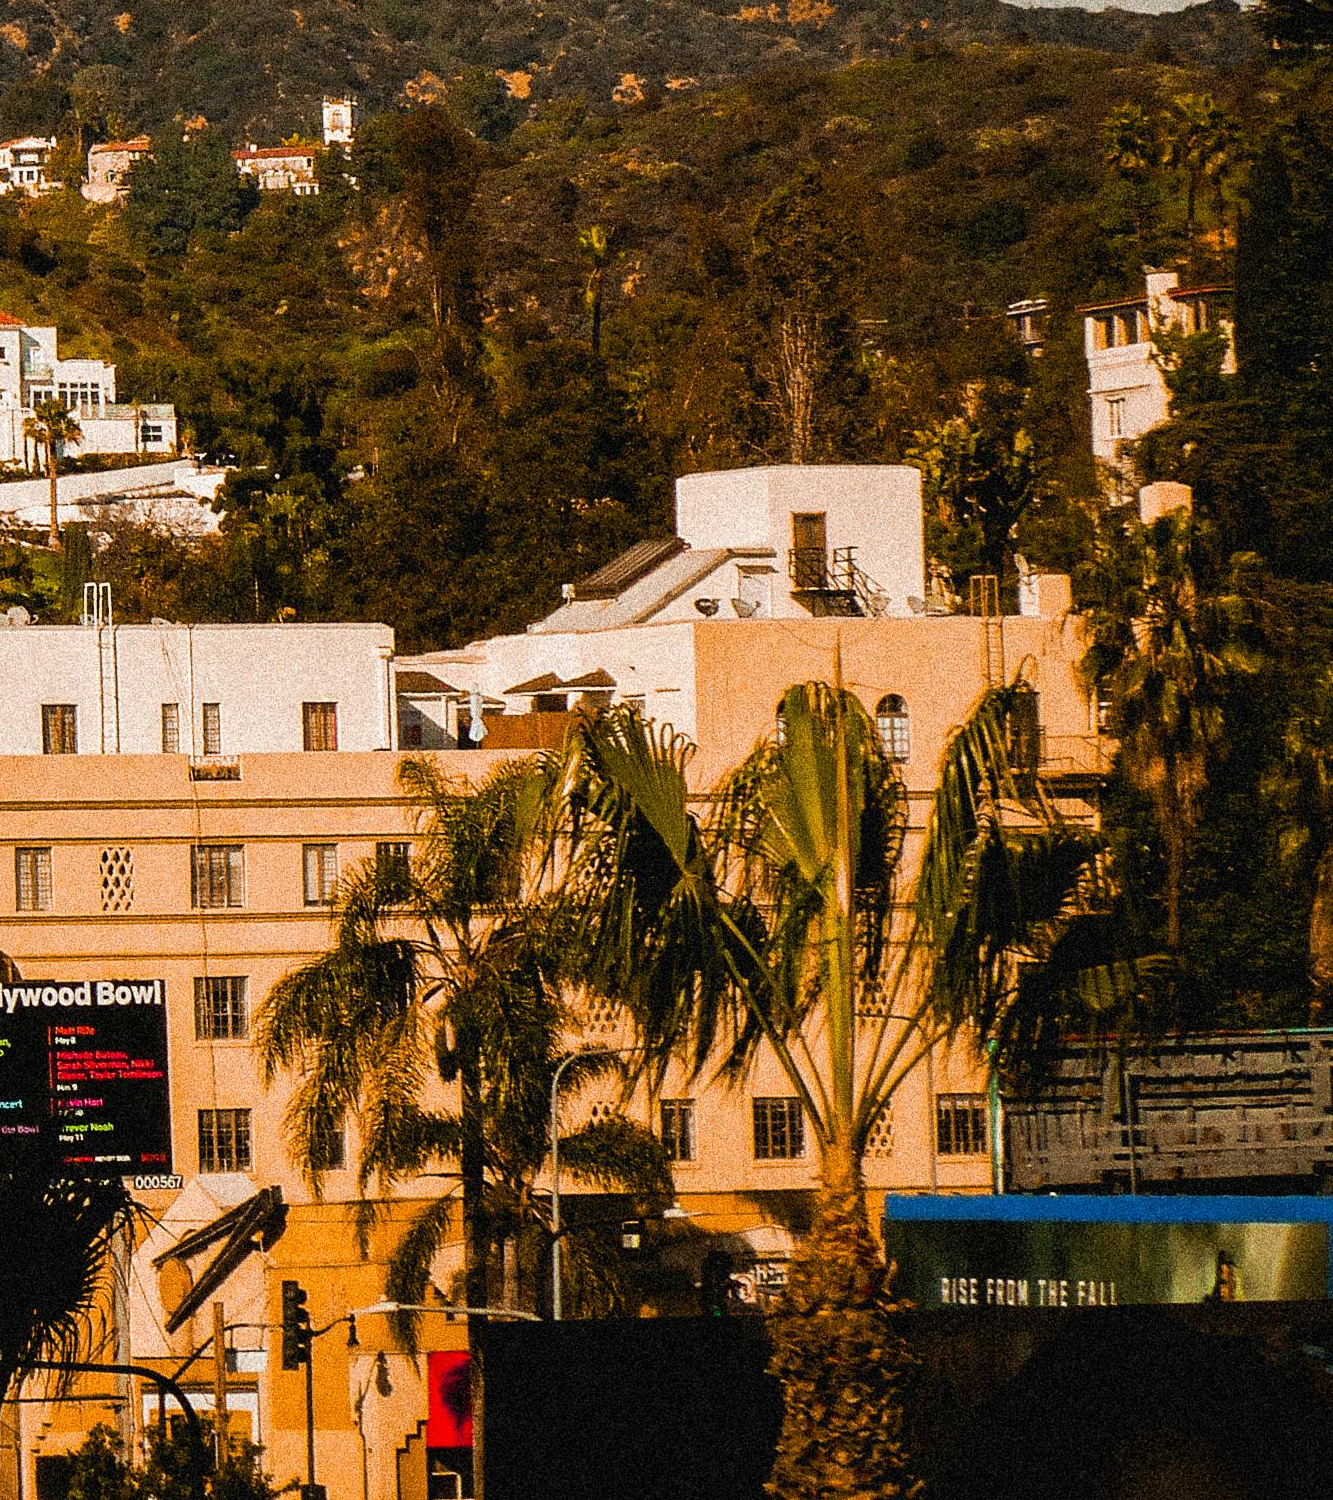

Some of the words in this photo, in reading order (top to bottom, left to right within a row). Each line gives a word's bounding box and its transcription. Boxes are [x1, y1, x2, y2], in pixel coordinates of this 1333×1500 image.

[96, 980, 162, 1006] Bowl
[135, 1175, 182, 1189] 000567
[941, 1277, 979, 1305] RISE
[986, 1278, 1029, 1306] FROM
[1038, 1279, 1068, 1307] THE
[1077, 1280, 1119, 1307] FALL
